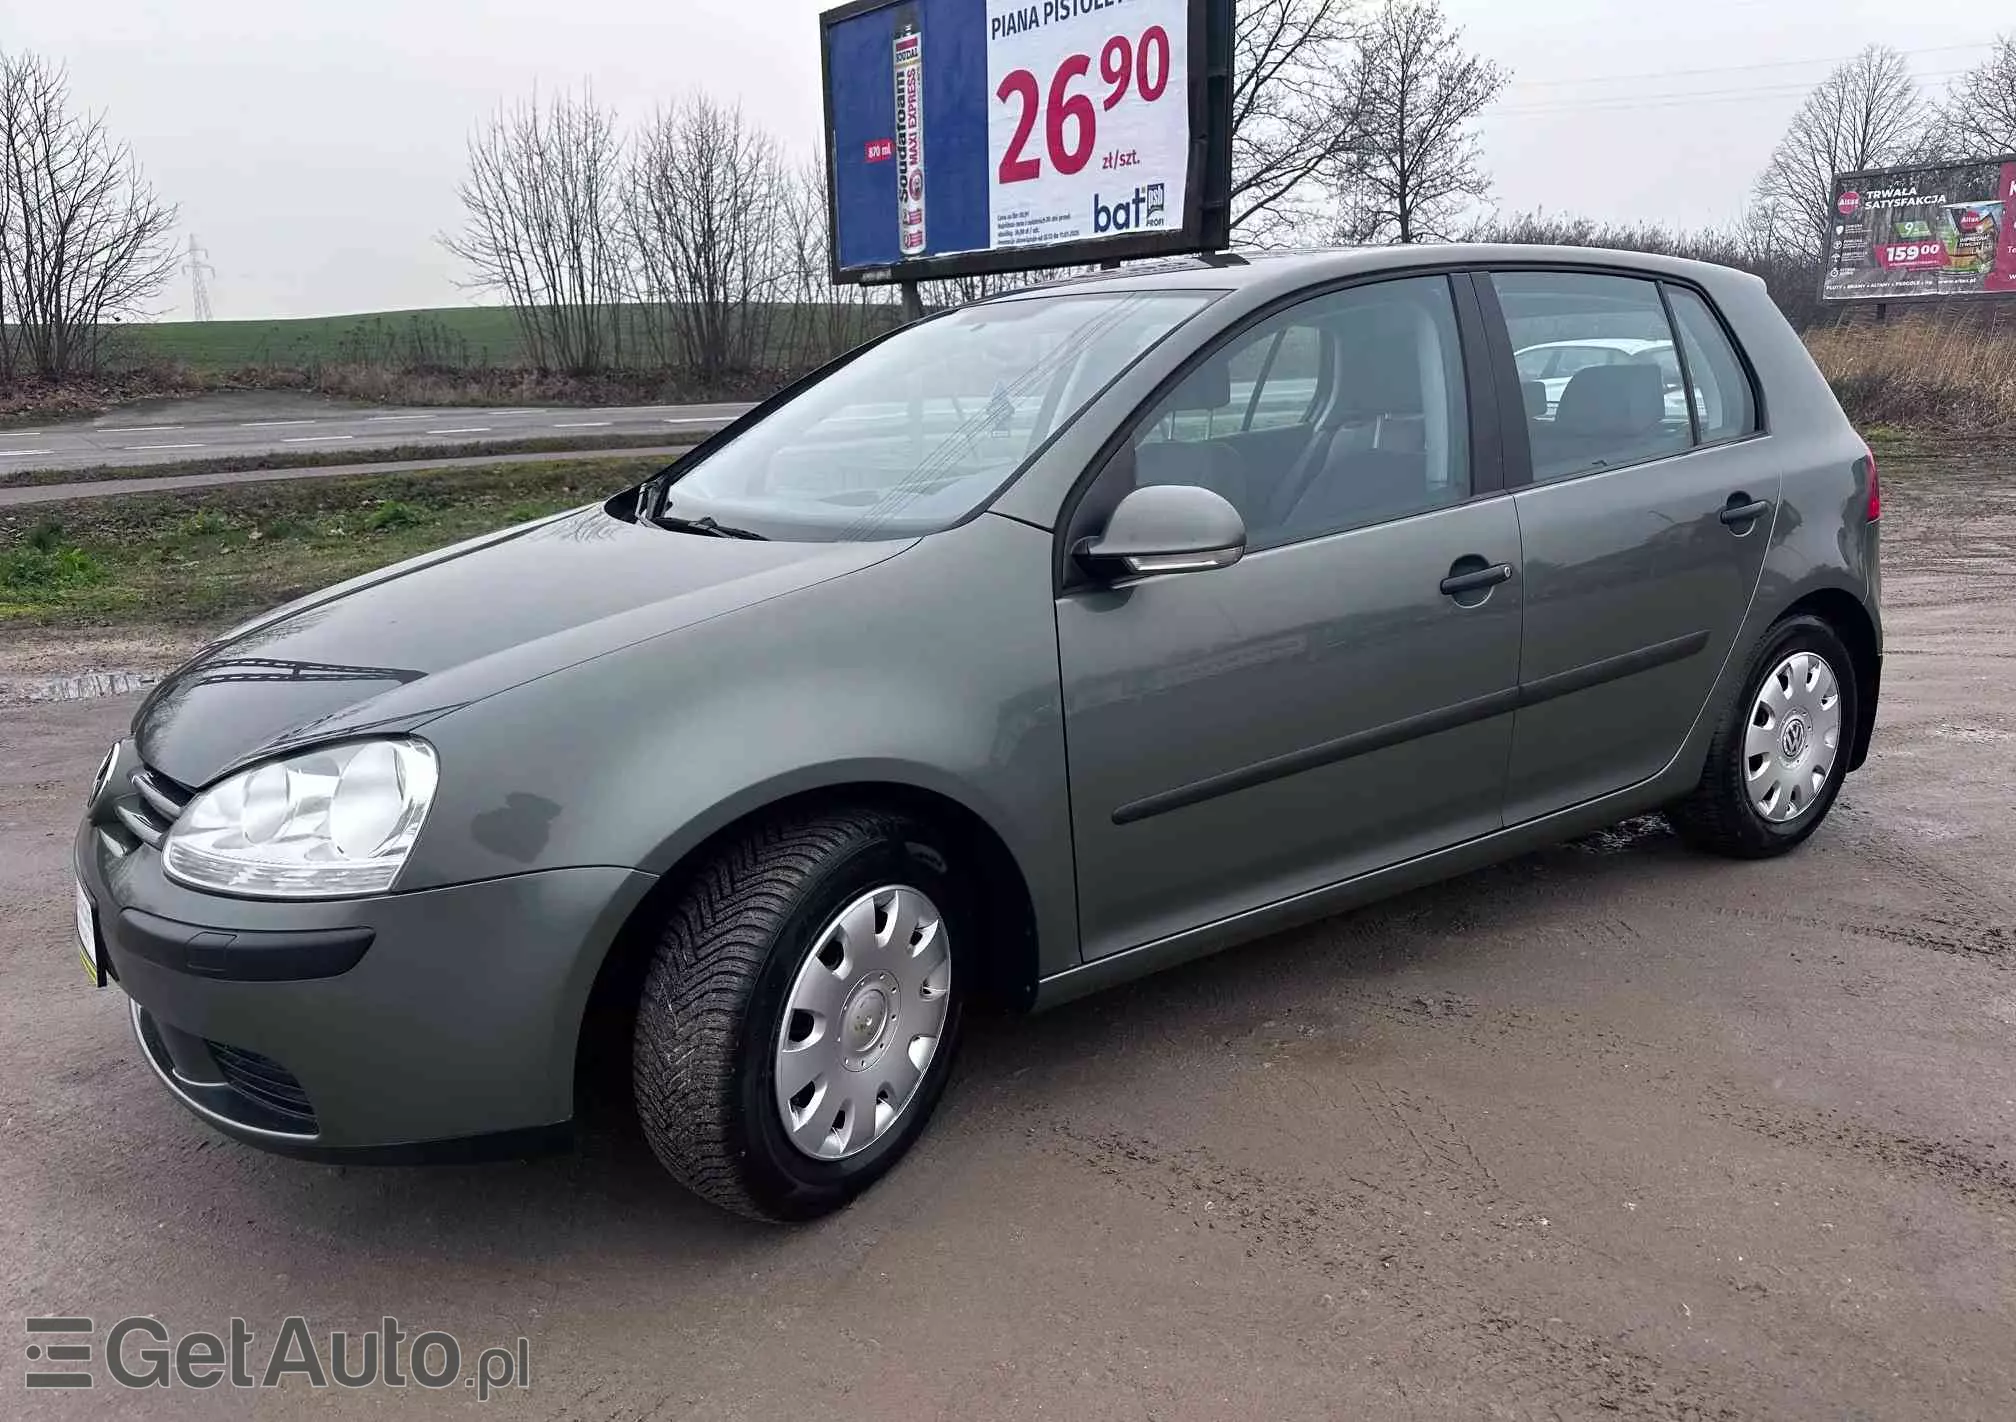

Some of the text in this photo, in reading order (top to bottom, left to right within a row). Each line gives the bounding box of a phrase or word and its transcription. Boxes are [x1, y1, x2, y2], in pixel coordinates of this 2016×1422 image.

[992, 6, 1040, 40] PIANA
[907, 68, 917, 129] EXPRESS
[896, 71, 908, 203] Soudafoam
[908, 132, 918, 165] MAXI
[1102, 149, 1141, 170] zł/szt.
[1093, 187, 1146, 234] bat
[1865, 194, 1947, 209] SATYSFAKCJA
